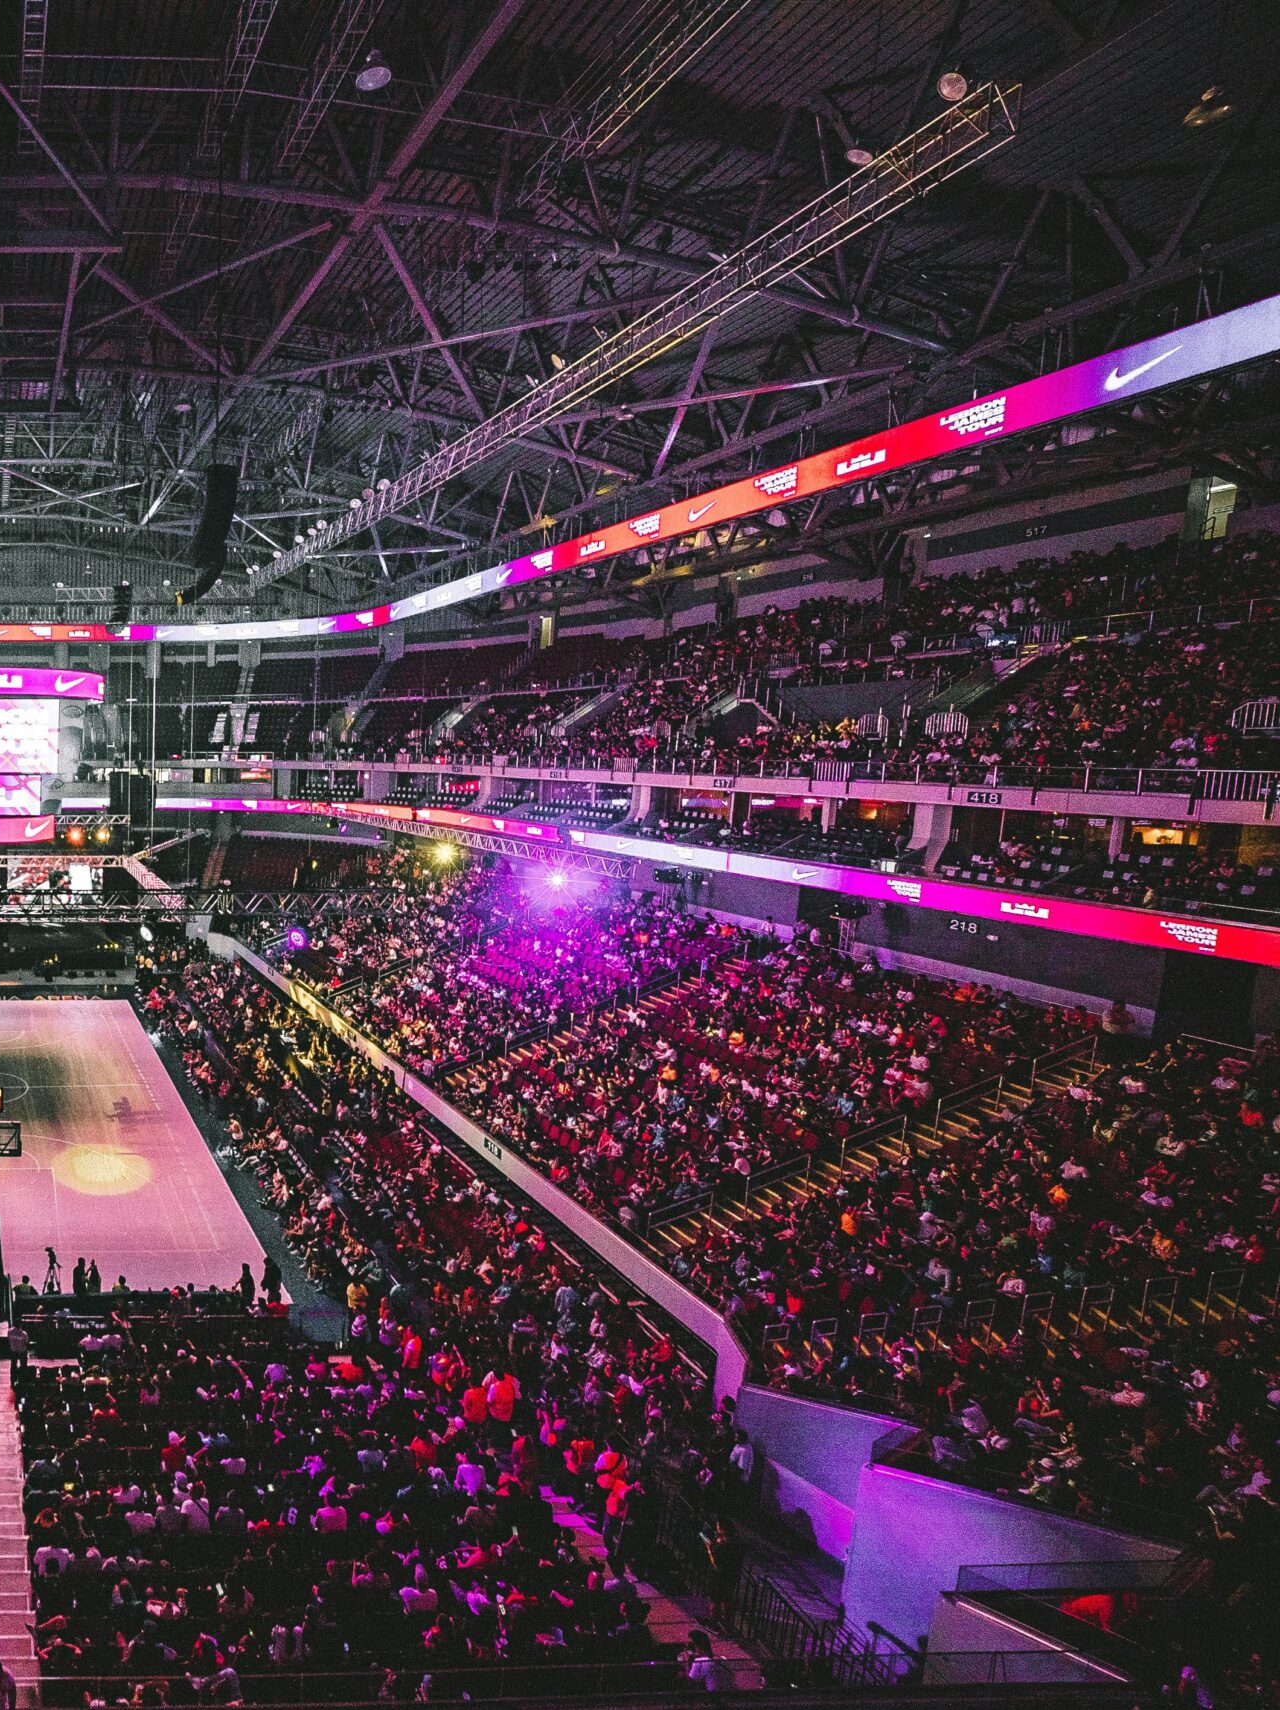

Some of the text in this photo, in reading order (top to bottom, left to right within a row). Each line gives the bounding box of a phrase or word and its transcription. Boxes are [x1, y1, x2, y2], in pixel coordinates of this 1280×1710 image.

[940, 396, 1006, 426] LEBRON
[949, 406, 1005, 430] JAMES
[958, 414, 1004, 435] TOUR
[1025, 525, 1047, 538] 517
[714, 779, 732, 788] 417
[970, 793, 998, 804] 418
[950, 919, 978, 934] 218
[1160, 921, 1218, 935] LEBRON
[1167, 929, 1217, 941] JAMES
[1176, 934, 1217, 947] TOUR
